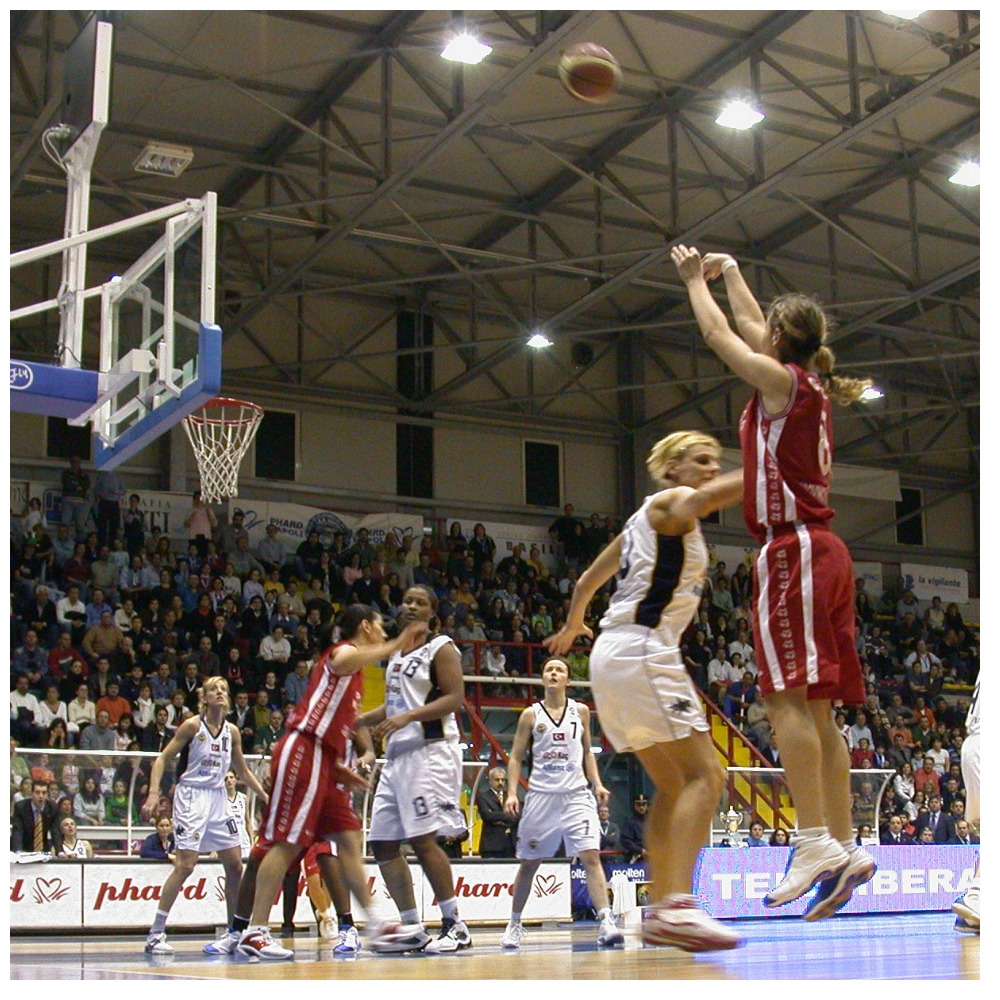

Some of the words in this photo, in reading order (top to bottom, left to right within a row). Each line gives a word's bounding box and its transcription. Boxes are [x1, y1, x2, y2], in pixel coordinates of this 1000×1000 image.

[570, 721, 577, 739] 7
[226, 818, 238, 836] 10
[581, 819, 590, 835] 7
[93, 877, 207, 910] phad
